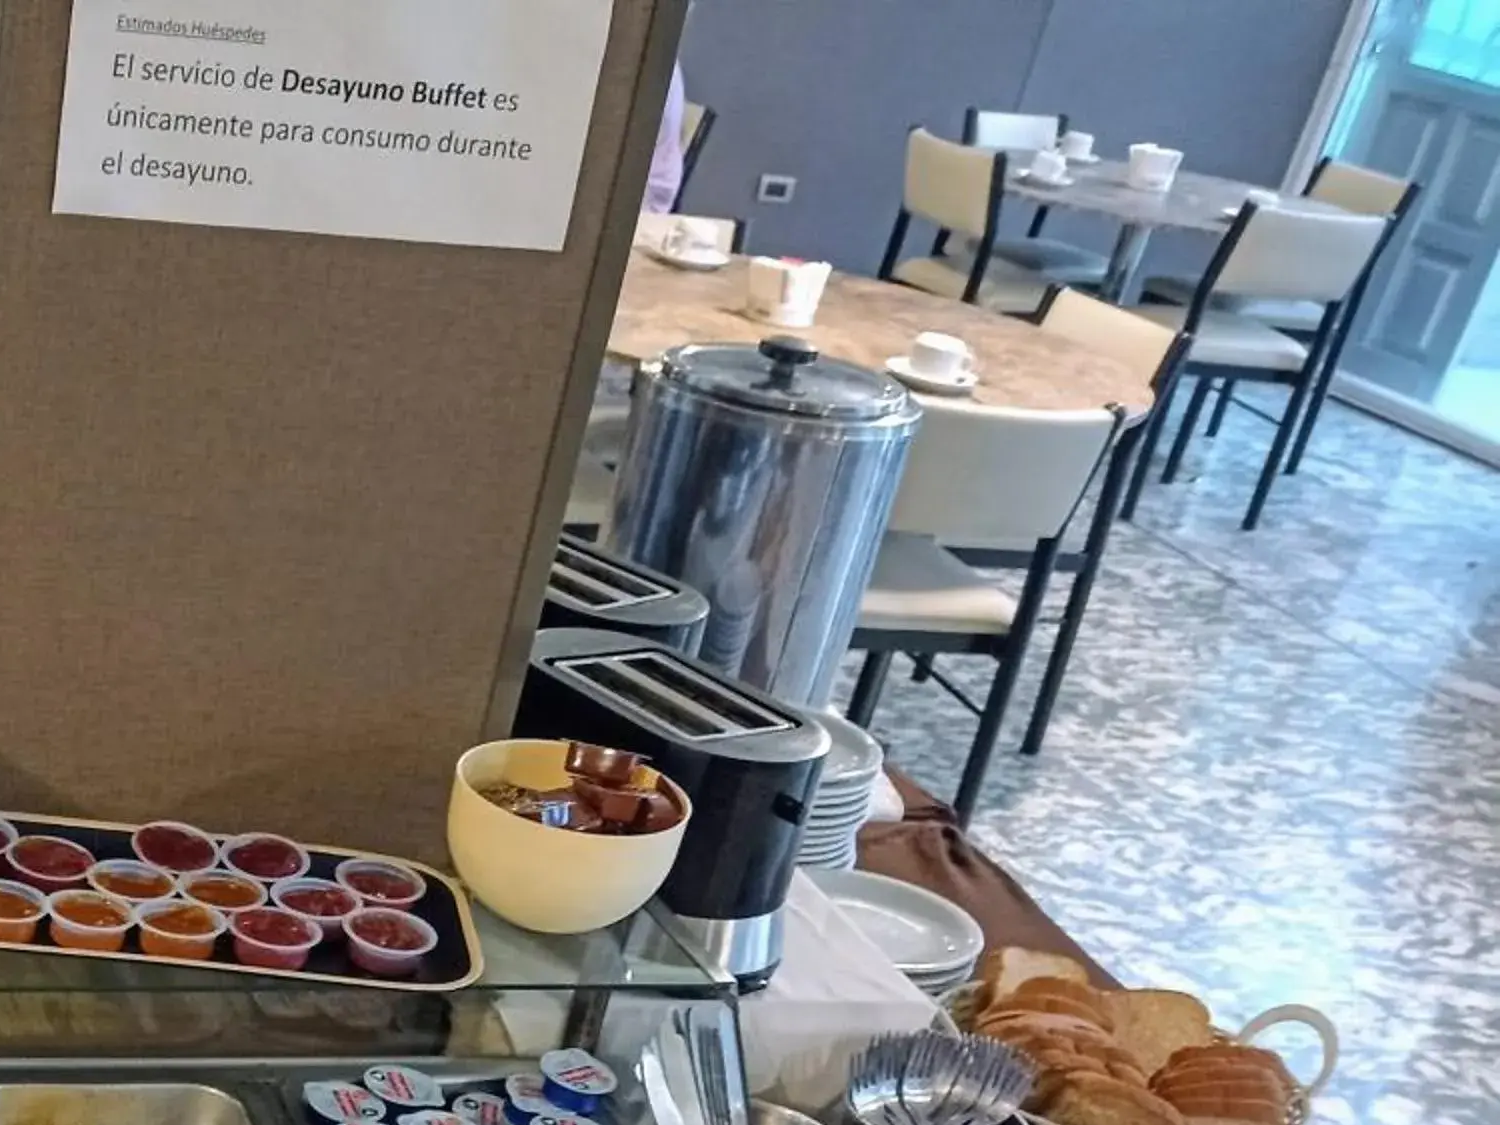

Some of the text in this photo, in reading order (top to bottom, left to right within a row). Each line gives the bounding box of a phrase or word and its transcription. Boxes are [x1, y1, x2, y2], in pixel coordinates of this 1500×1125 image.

[116, 14, 266, 43] Estimados Huéspedes
[113, 53, 520, 112] El servicio de Desayuno Buffet es
[107, 102, 532, 161] únicamente para consumo durante
[101, 150, 253, 186] el desayuno.
